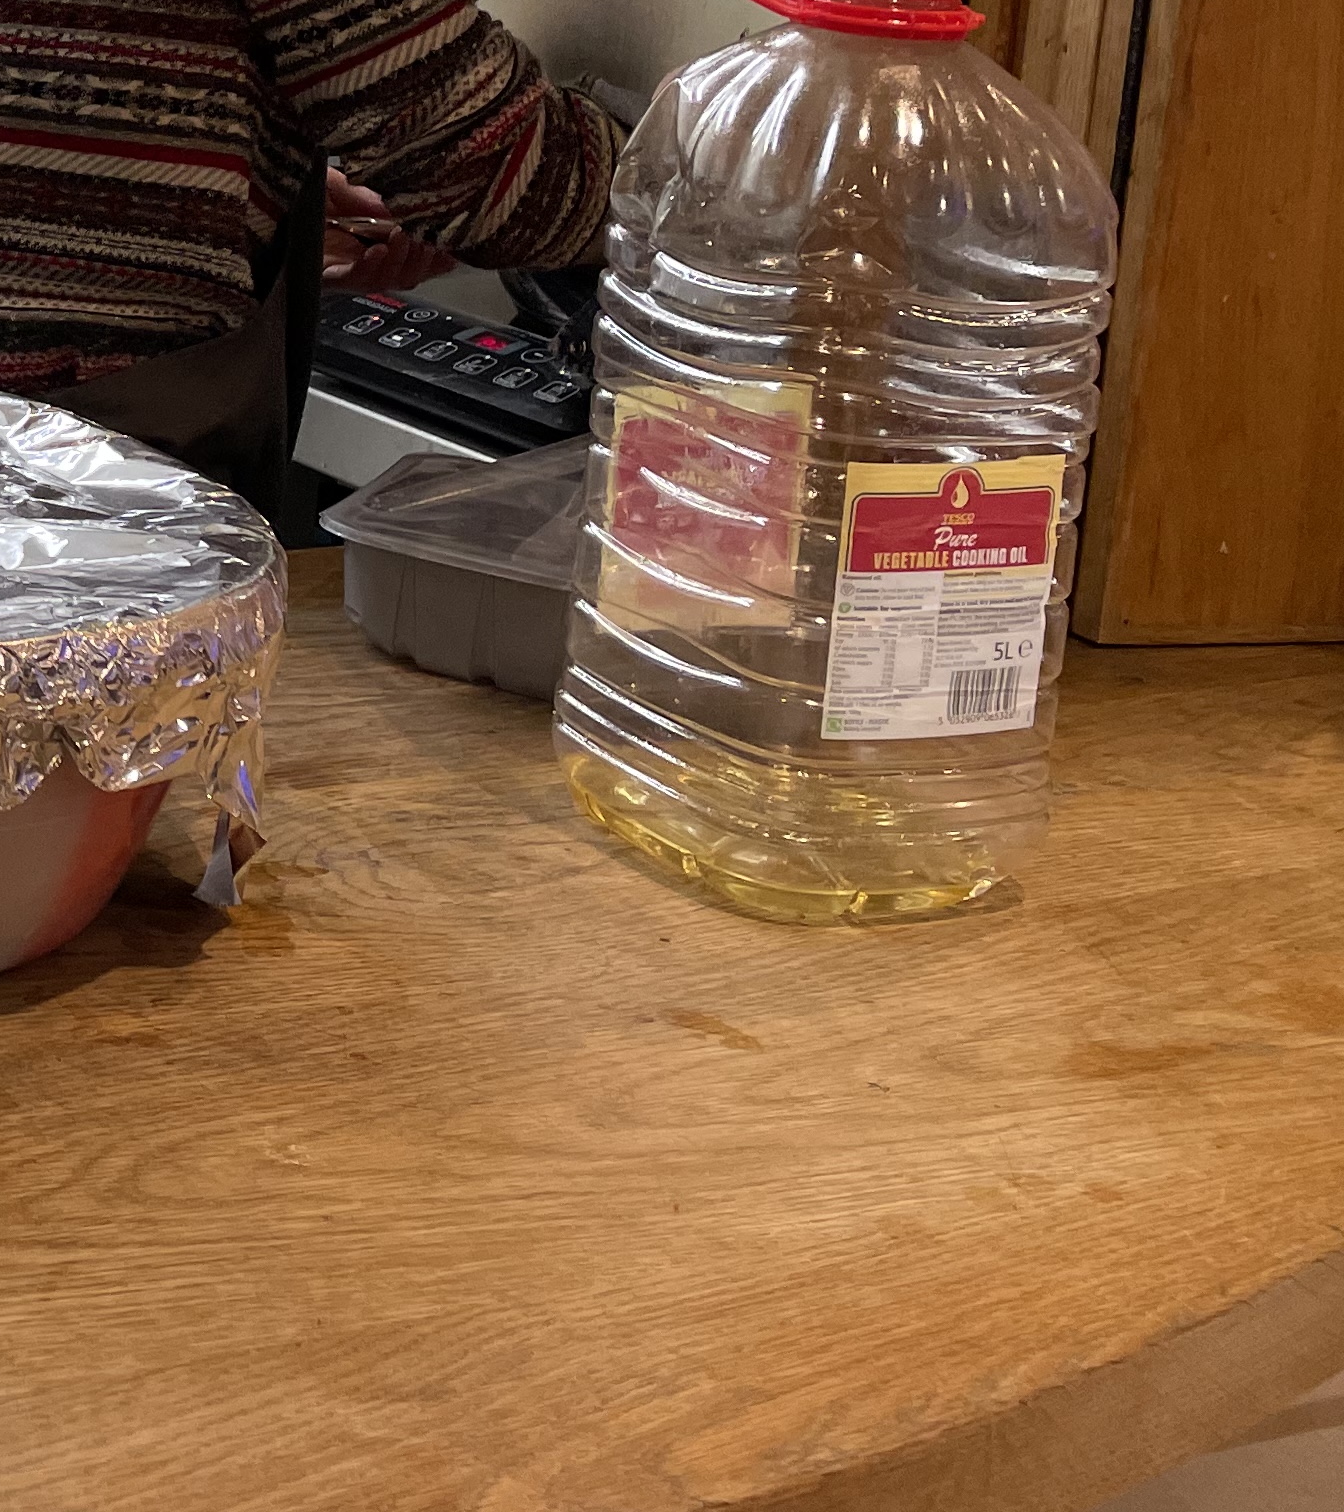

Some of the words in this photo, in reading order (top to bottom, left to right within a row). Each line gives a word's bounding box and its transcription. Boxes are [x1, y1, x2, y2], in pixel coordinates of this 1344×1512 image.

[943, 513, 974, 524] TESCO
[933, 526, 978, 550] Pure
[873, 550, 949, 569] VEGETABLE
[952, 547, 1006, 567] COOKING
[1009, 546, 1027, 564] OIL
[993, 642, 1013, 661] 5L
